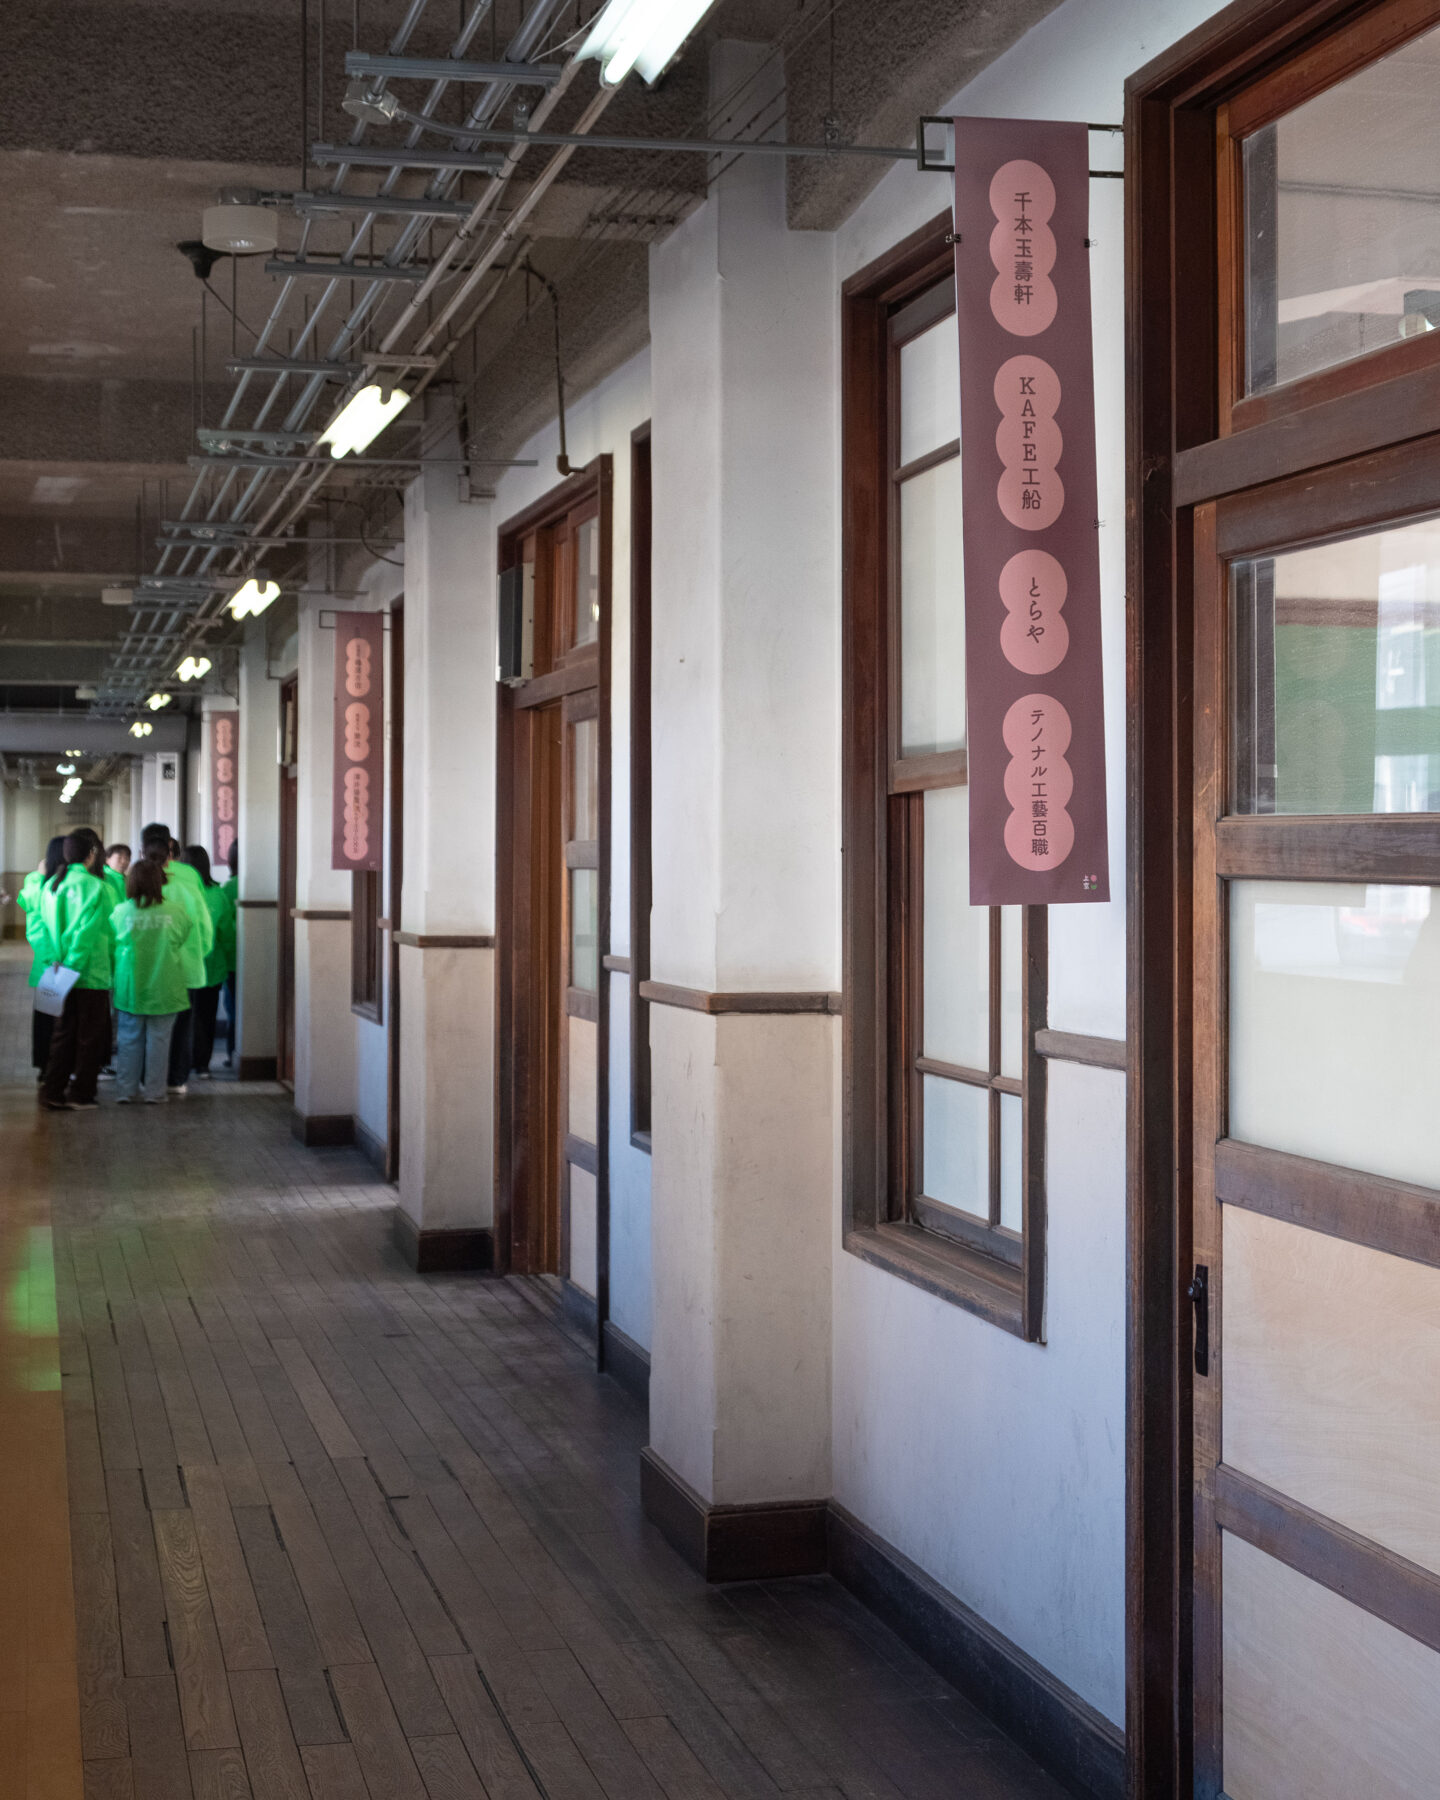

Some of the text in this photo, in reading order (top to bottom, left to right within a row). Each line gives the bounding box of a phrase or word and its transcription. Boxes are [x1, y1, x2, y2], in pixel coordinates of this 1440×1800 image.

[1013, 192, 1033, 305] 千本玉壽軒
[1027, 577, 1045, 643] とらや
[1031, 710, 1049, 856] テノナル工藝百職
